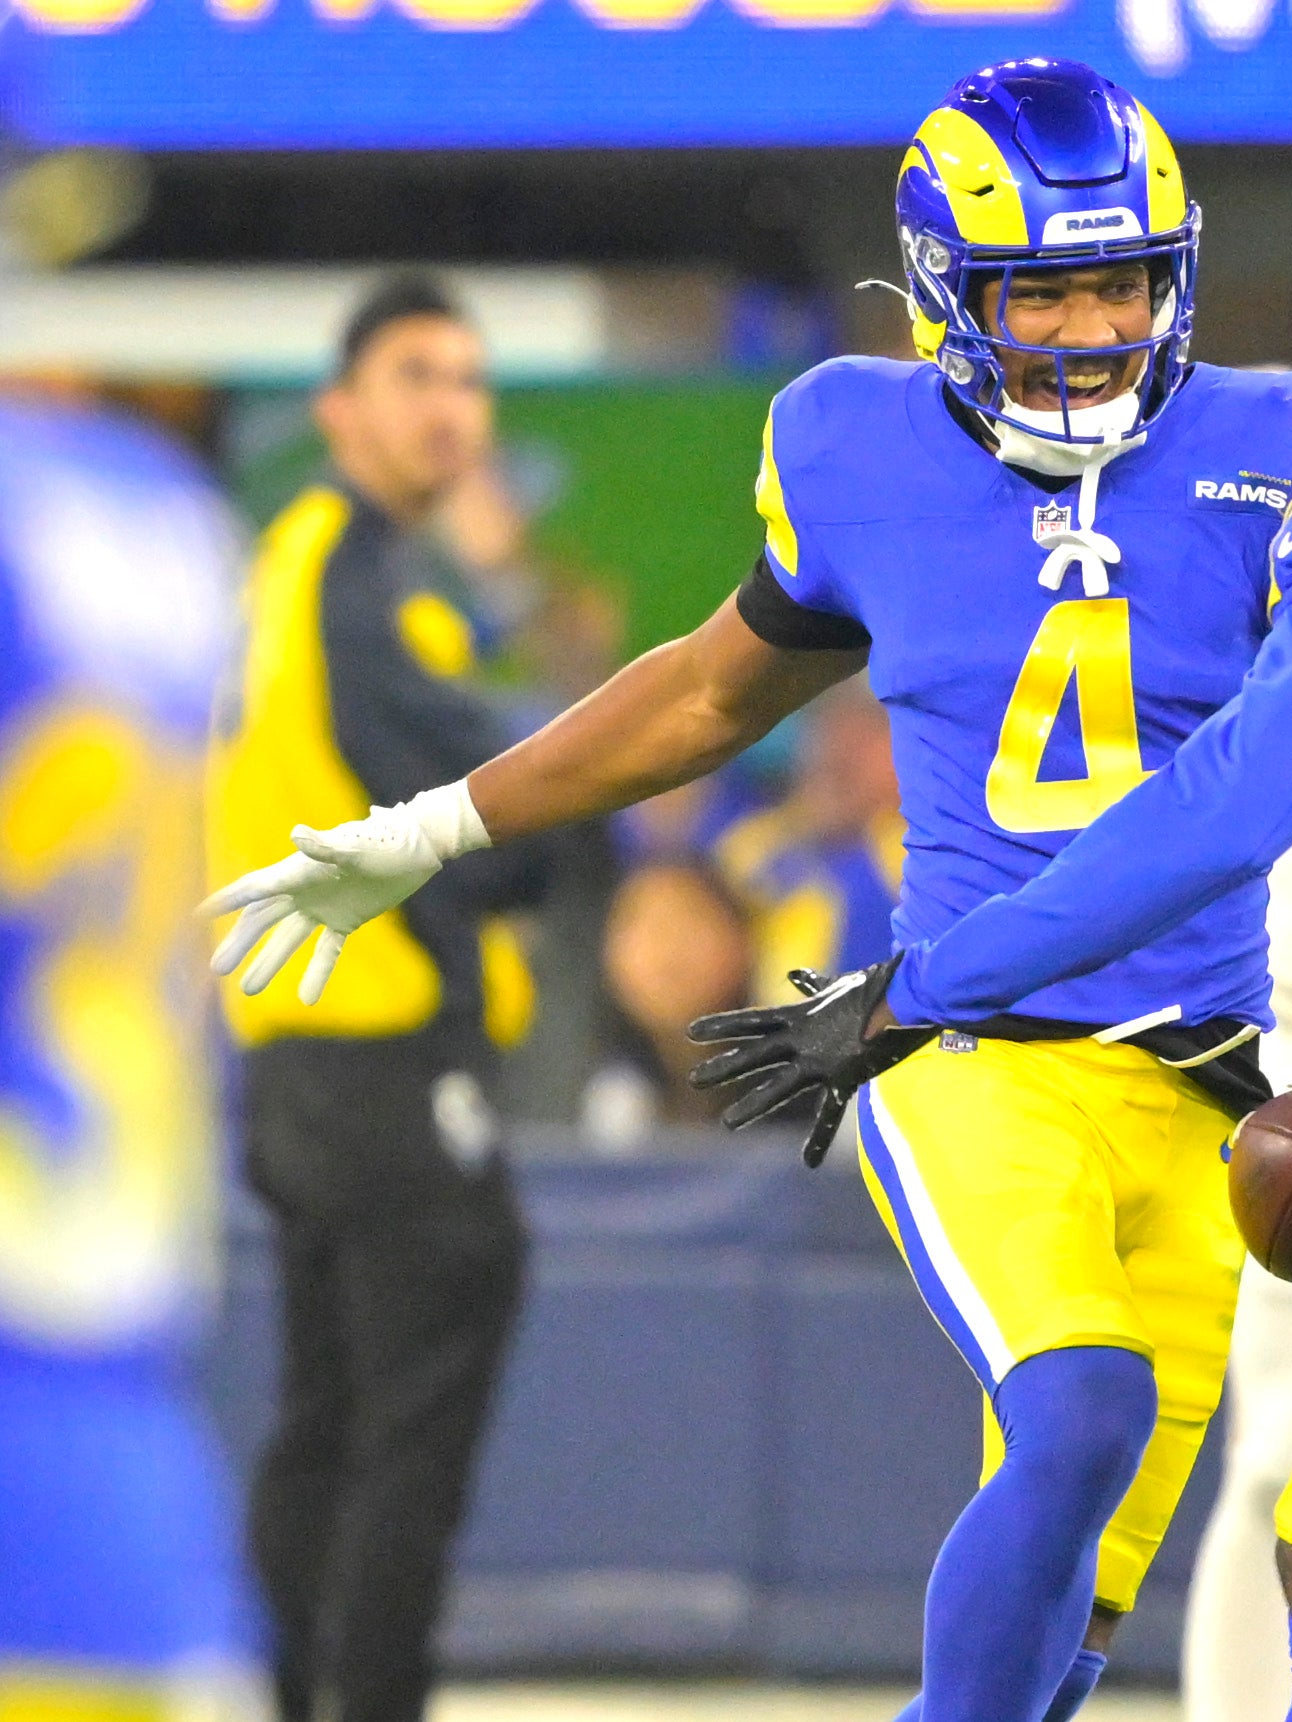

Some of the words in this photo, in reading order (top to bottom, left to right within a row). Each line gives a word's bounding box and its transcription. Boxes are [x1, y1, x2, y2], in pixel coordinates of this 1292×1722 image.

[1066, 214, 1125, 231] RAMS
[1195, 480, 1288, 509] RAMS
[985, 597, 1158, 833] 4
